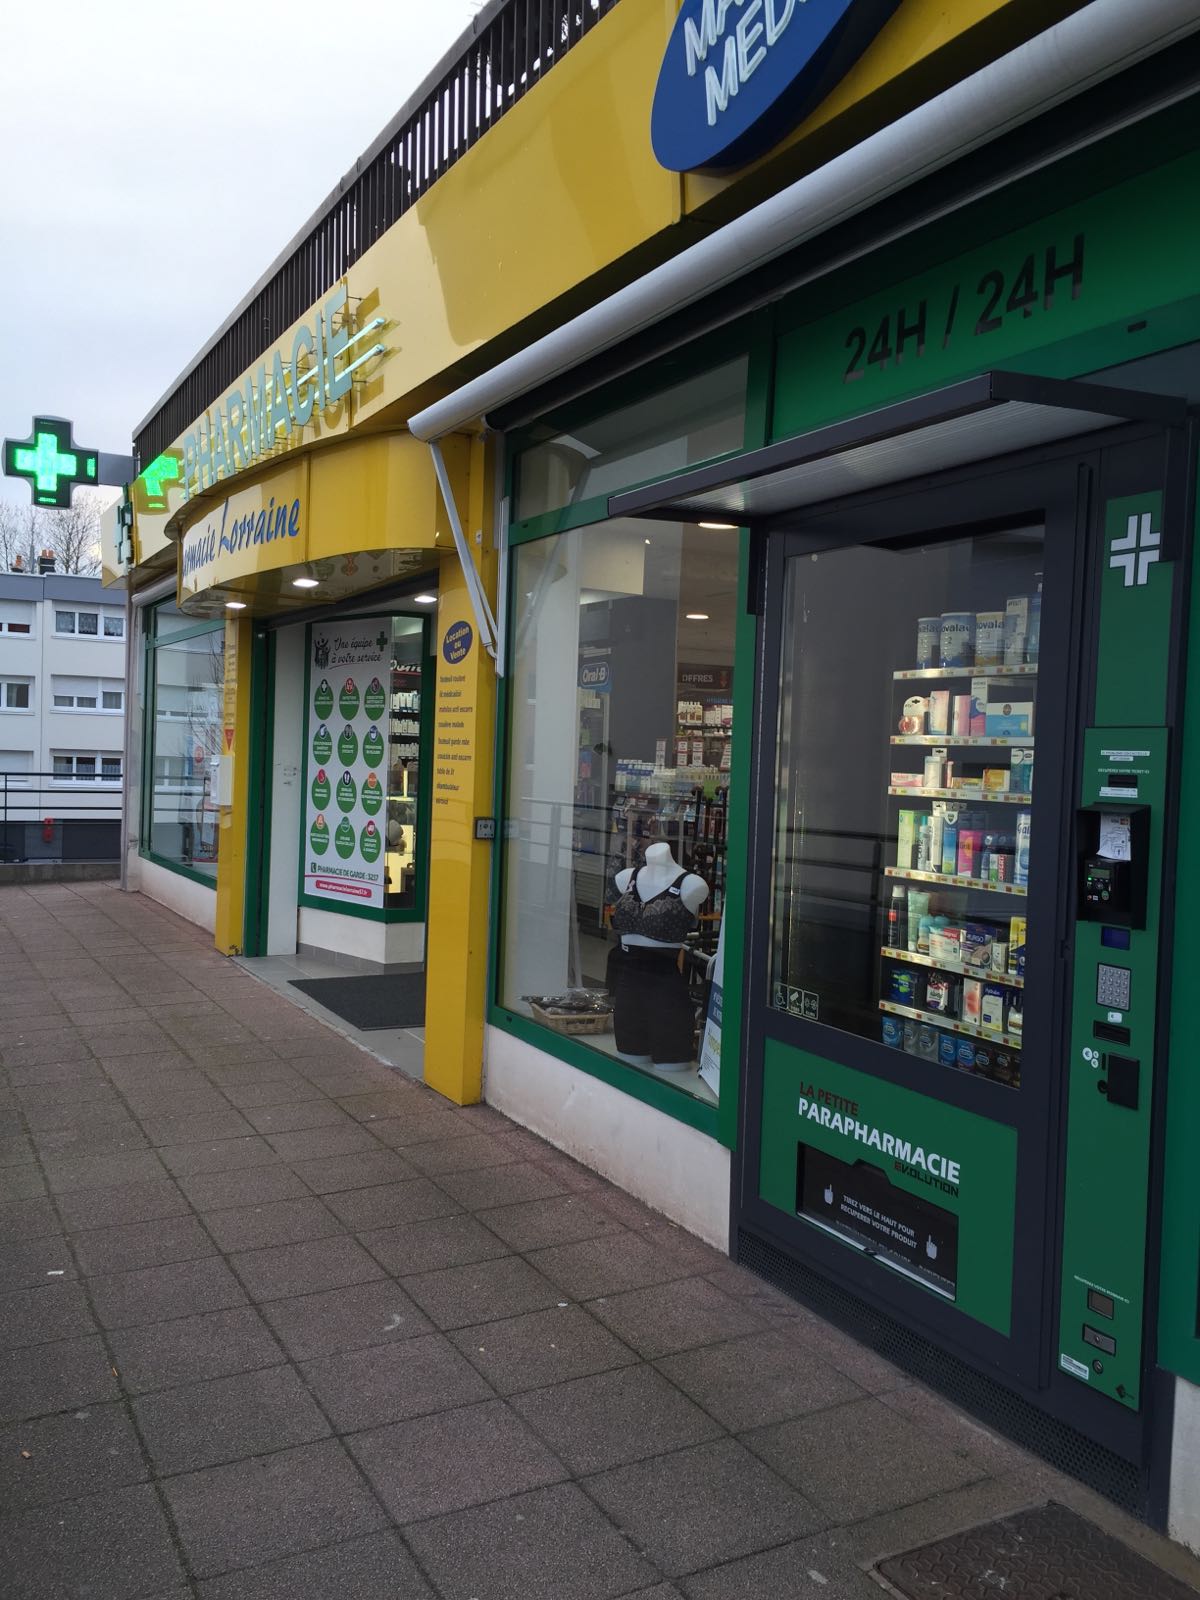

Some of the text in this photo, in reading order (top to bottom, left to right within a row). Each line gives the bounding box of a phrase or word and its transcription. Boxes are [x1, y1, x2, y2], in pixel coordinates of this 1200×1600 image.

[843, 232, 1086, 384] 24H / 24H
[182, 283, 354, 501] PHARMACIE
[217, 496, 301, 559] Lorraine
[334, 636, 374, 651] Une équipe
[445, 626, 470, 644] Location
[338, 652, 355, 663] votre
[357, 651, 382, 663] service
[449, 647, 466, 661] Vente
[582, 666, 607, 683] Oral-B
[681, 673, 713, 684] OFFRES
[317, 865, 343, 876] PHARMACIE
[343, 869, 349, 877] DE
[349, 870, 366, 880] GARDE
[799, 1081, 859, 1117] LA PETITE
[798, 1097, 961, 1185] PARAPHARMACIE
[843, 1194, 915, 1238] TIREZ VERS LE HAUT POUR
[871, 1219, 891, 1236] VOTRE
[891, 1229, 918, 1249] PRODUIT
